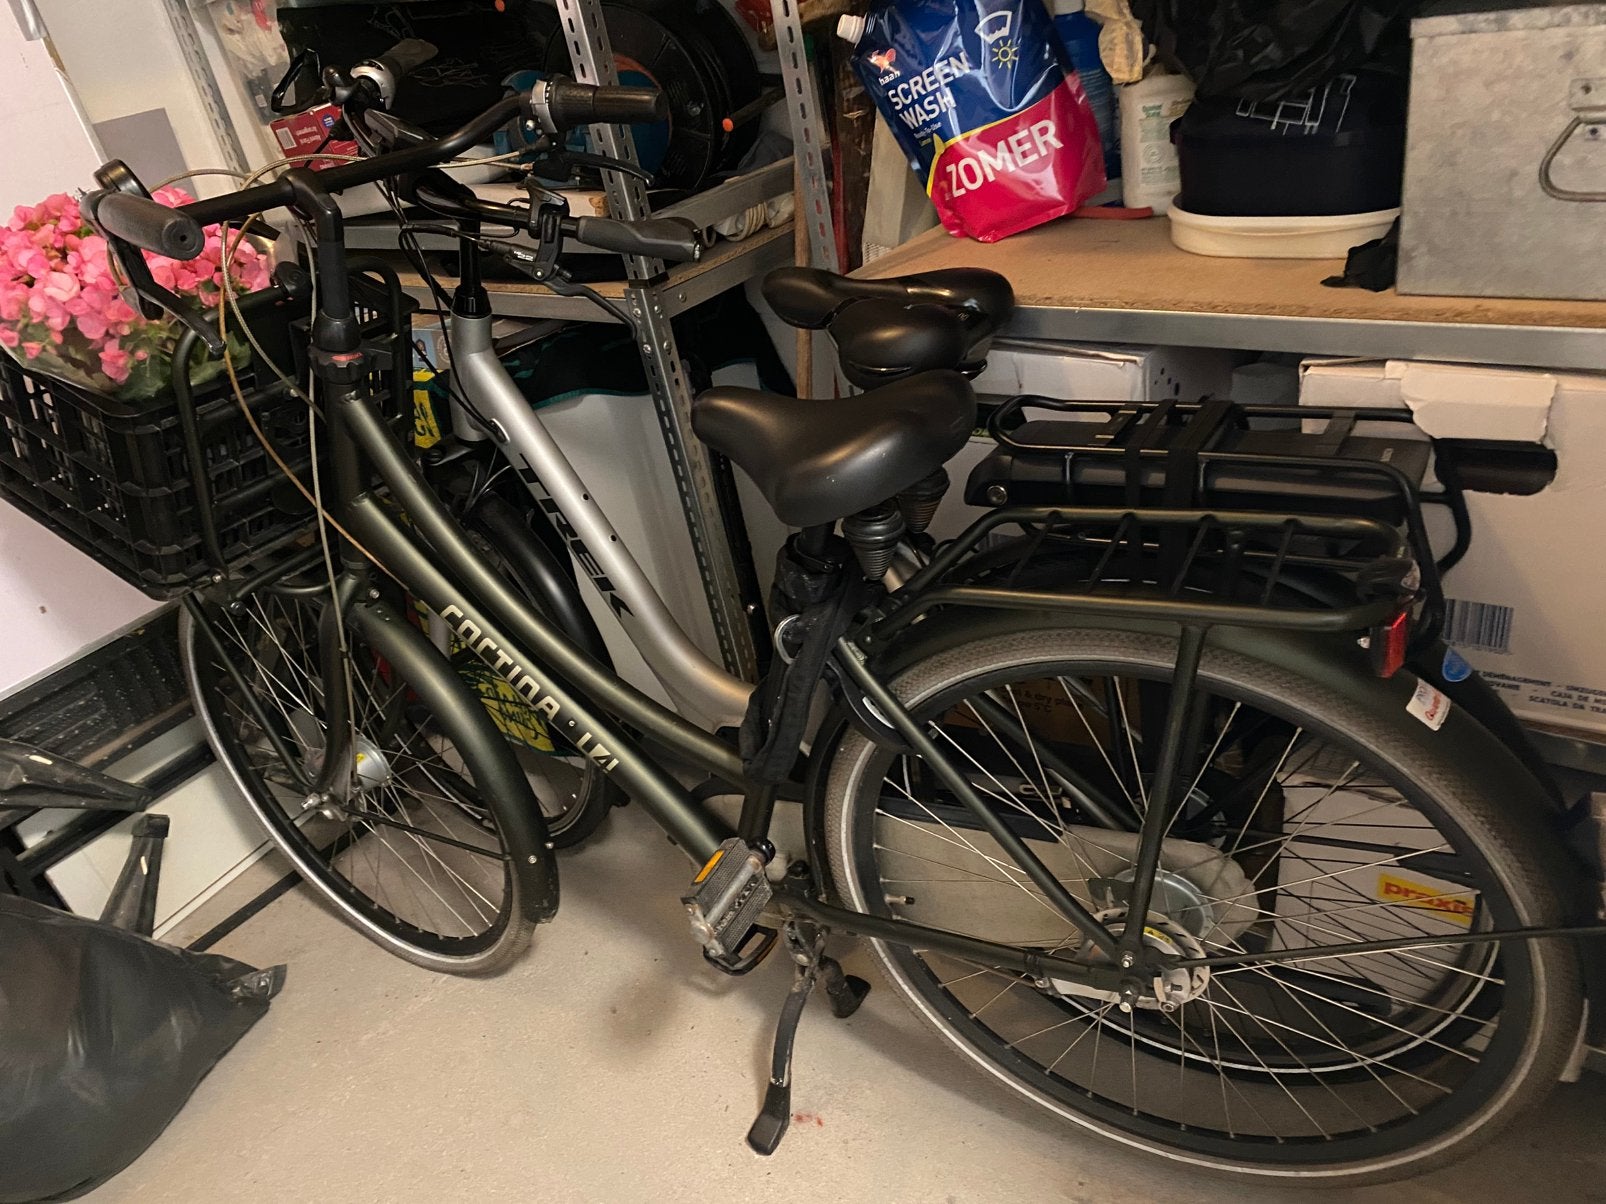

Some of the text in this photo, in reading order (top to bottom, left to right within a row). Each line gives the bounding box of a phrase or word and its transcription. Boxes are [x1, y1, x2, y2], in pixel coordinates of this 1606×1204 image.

[888, 51, 971, 111] SCREEN
[899, 86, 957, 130] WASH
[946, 119, 1064, 198] ZOMER
[518, 452, 635, 620] TREK
